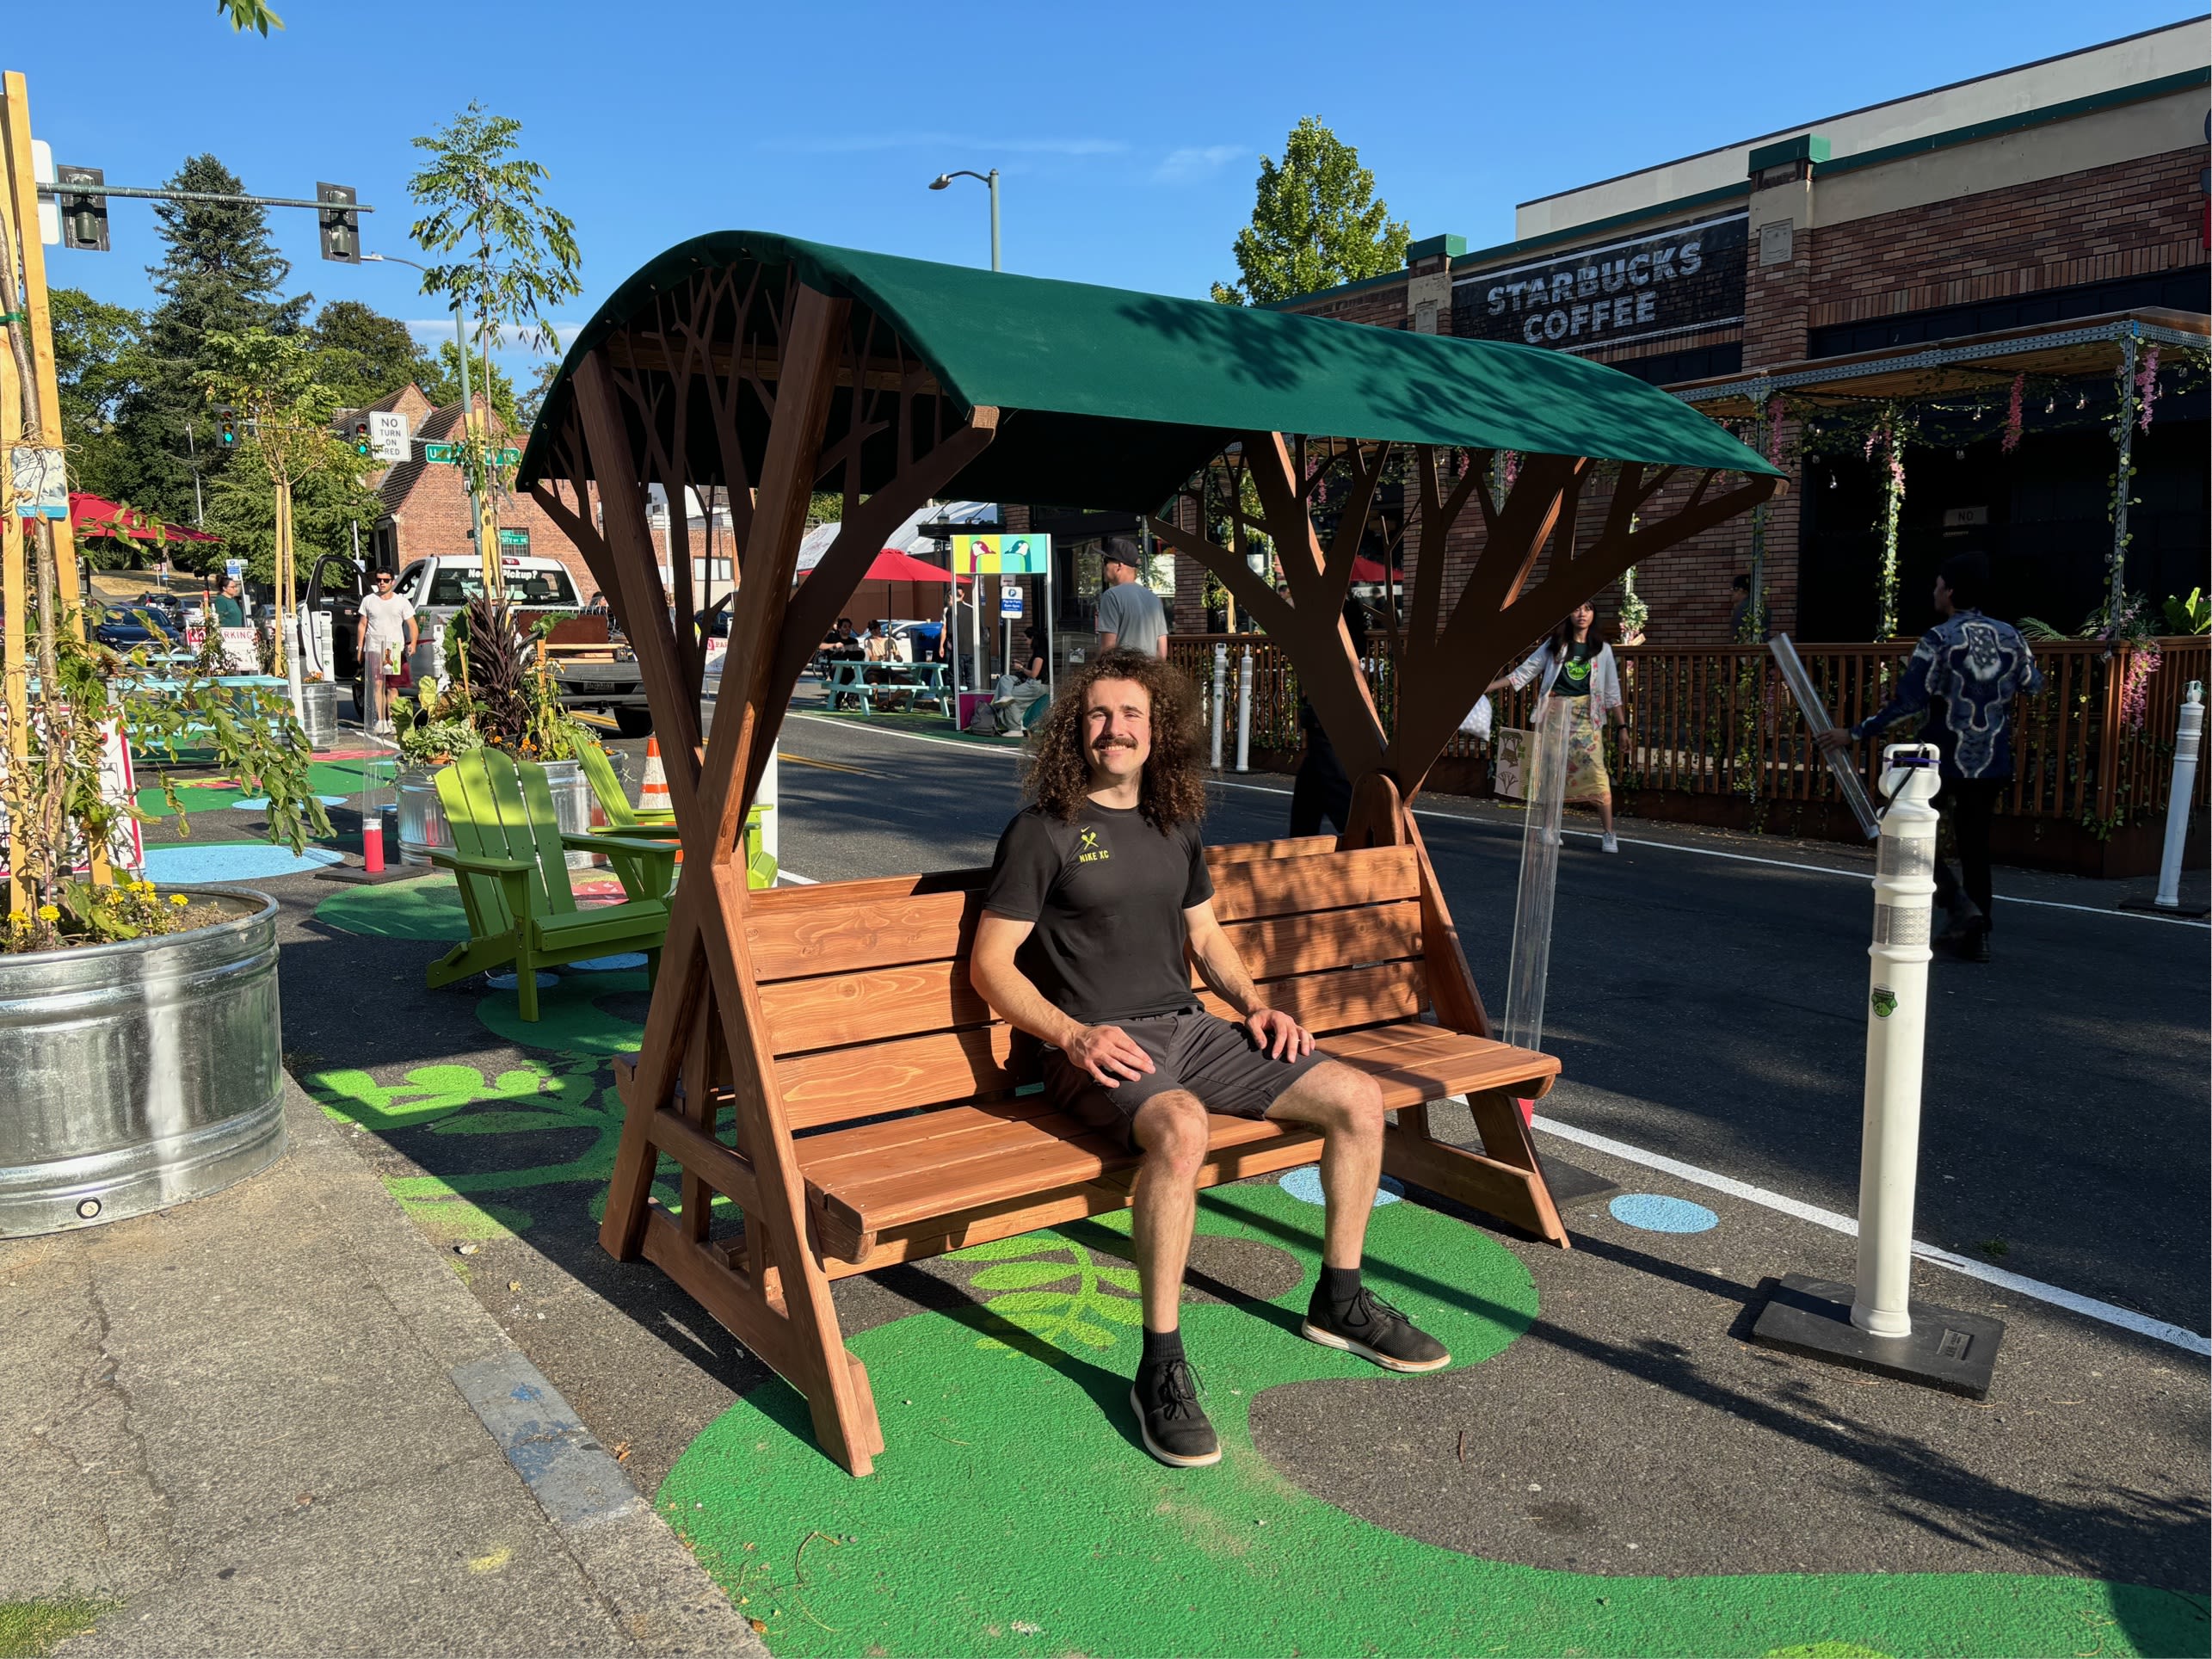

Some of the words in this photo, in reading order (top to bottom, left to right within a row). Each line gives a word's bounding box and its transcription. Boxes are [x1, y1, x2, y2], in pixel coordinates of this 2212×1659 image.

[1488, 242, 1702, 316] STARBUCKS
[1523, 290, 1657, 344] COFFEE
[381, 418, 398, 428] NO
[380, 429, 402, 438] TURN
[385, 438, 397, 447] ON
[384, 447, 400, 456] RED
[1958, 510, 1974, 521] NO
[502, 570, 538, 580] Pickup?
[1099, 849, 1110, 860] XC
